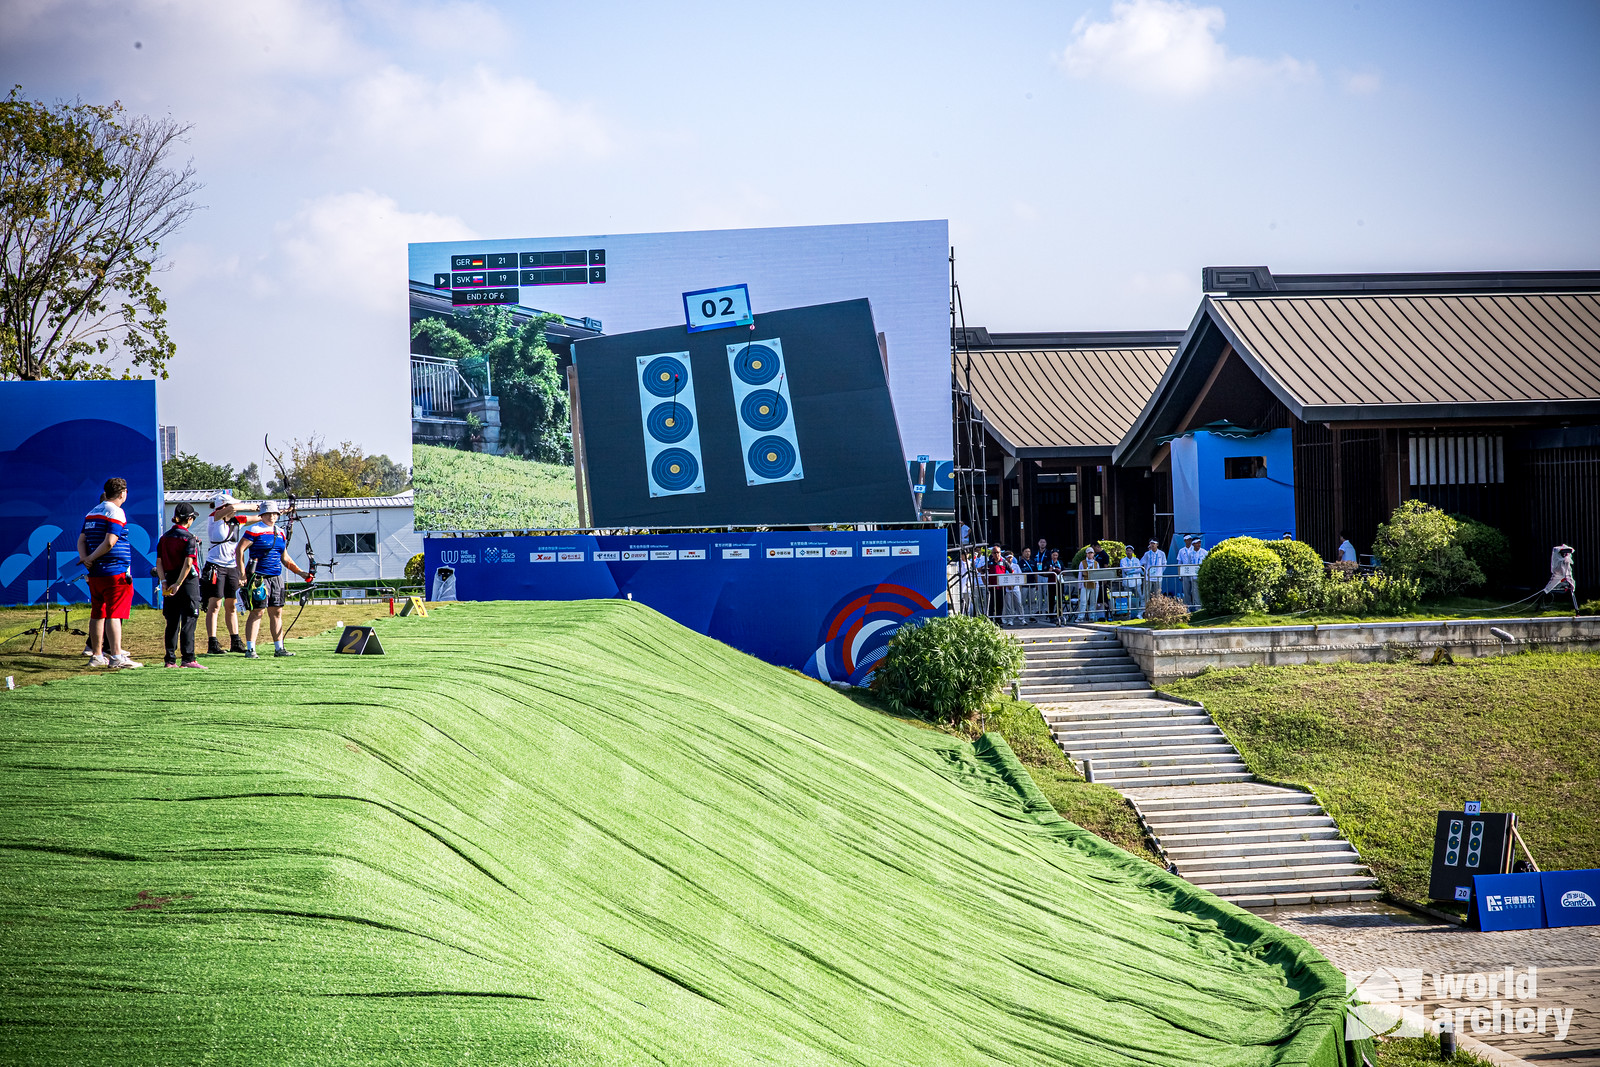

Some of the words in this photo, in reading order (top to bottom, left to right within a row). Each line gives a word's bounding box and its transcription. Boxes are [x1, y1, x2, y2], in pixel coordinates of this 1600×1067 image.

[455, 258, 471, 266] GER
[498, 257, 506, 265] 21
[529, 273, 534, 281] 3
[488, 292, 499, 300] OF
[701, 297, 735, 318] 02
[342, 629, 363, 653] 2
[1468, 804, 1477, 812] 02
[1458, 889, 1468, 897] 20
